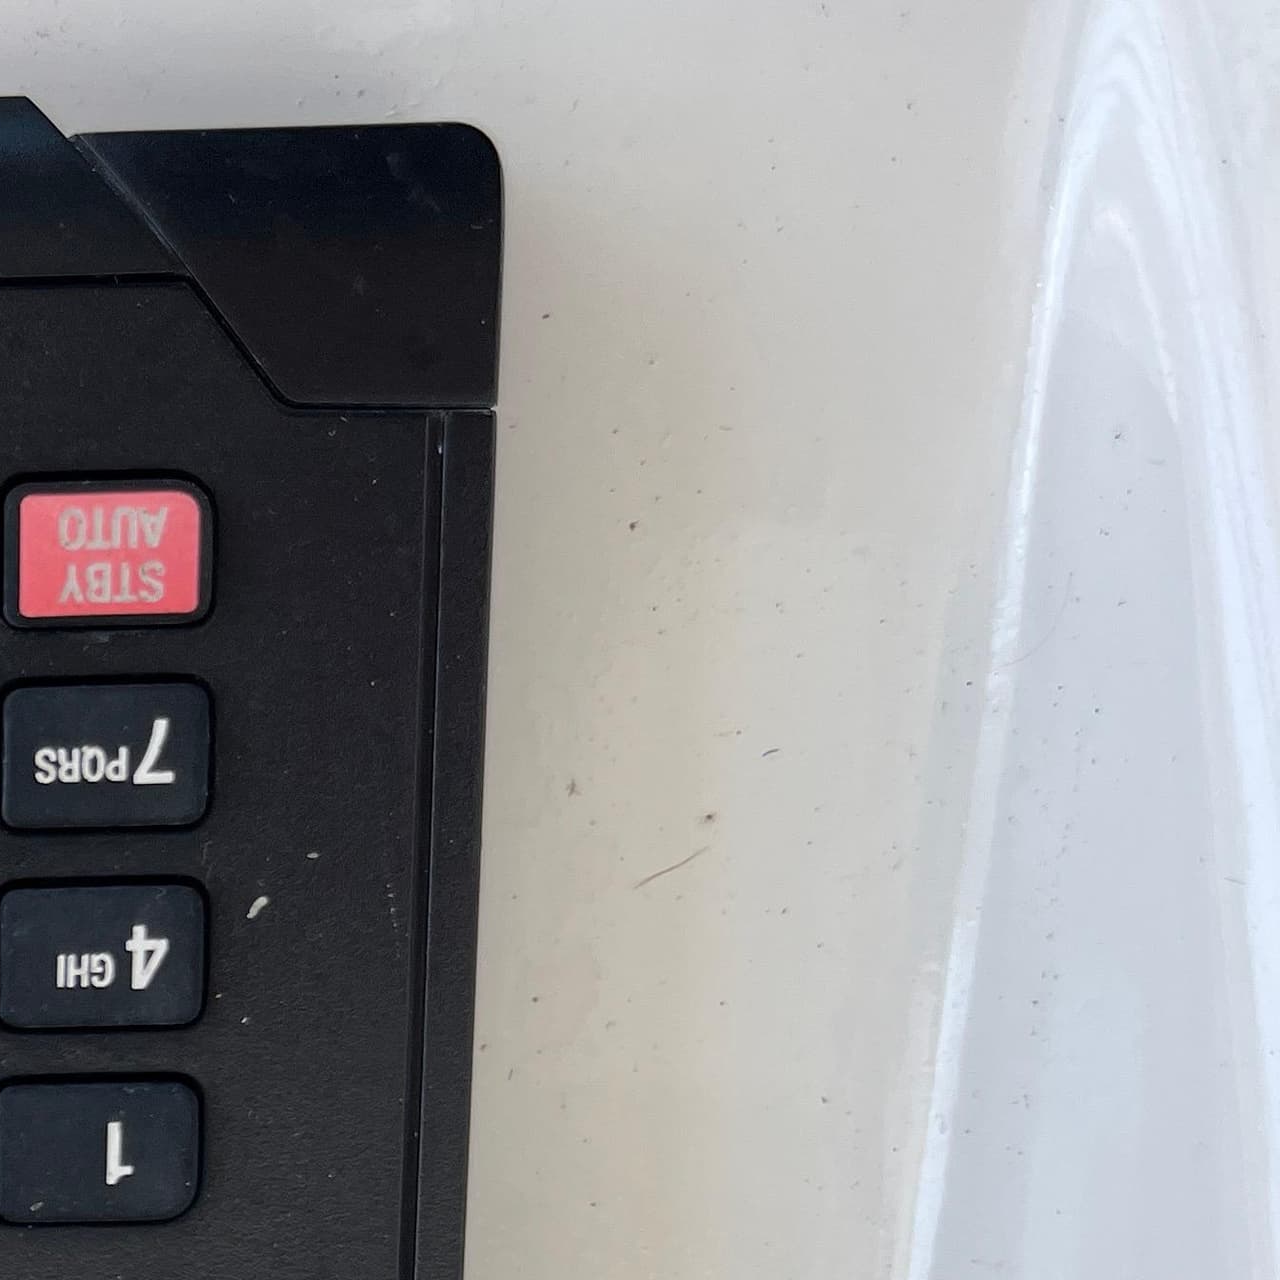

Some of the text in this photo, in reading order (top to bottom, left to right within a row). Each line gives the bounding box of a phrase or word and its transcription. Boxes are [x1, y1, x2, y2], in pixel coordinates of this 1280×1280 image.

[59, 507, 168, 549] AUTO
[60, 563, 166, 602] STBY
[34, 718, 176, 785] 7 PQRS
[56, 924, 169, 990] 4 GHI
[105, 1121, 134, 1185] 1
